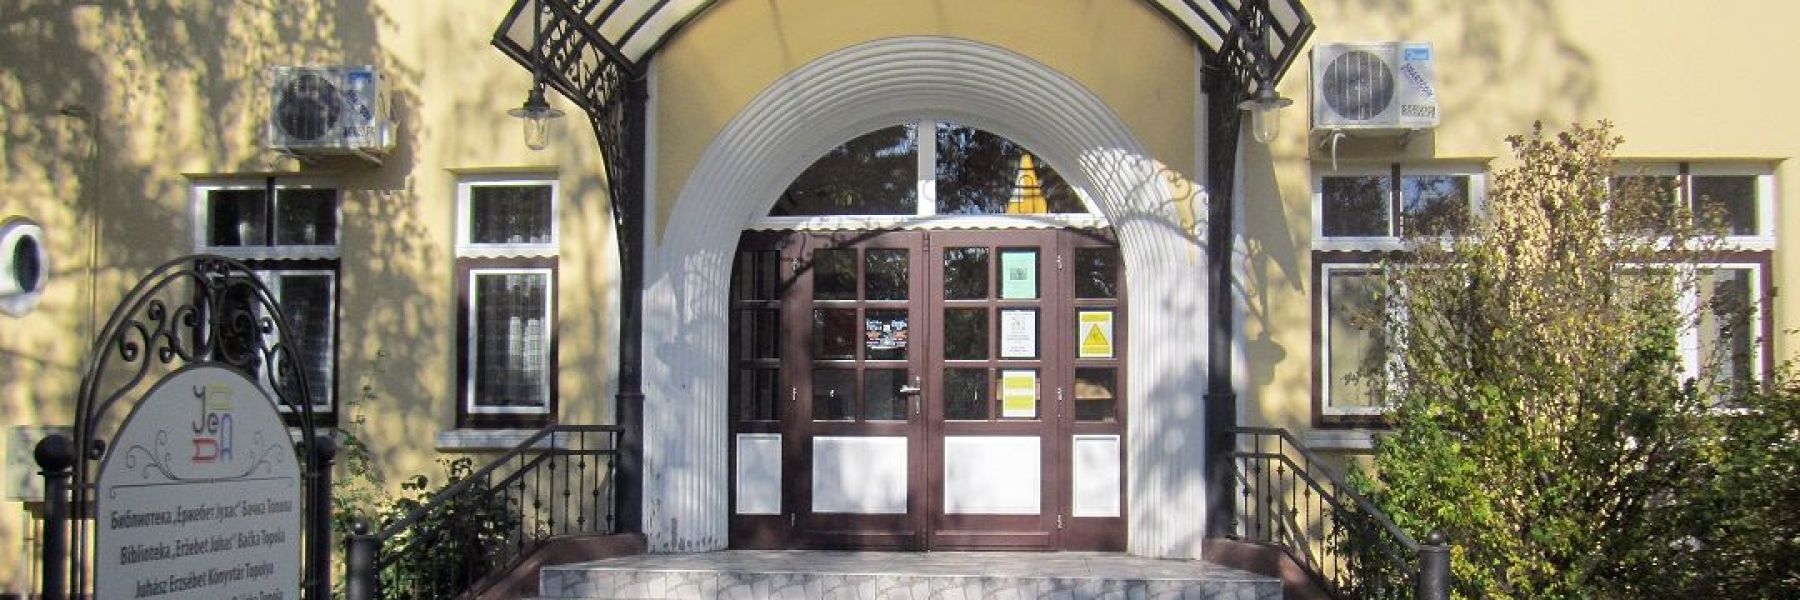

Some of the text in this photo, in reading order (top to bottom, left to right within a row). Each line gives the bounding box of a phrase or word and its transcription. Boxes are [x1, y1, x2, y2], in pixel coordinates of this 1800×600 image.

[111, 510, 172, 530] Библиотека
[120, 542, 171, 566] Biblioteka
[238, 531, 261, 549] Bačka
[261, 528, 286, 548] Topola
